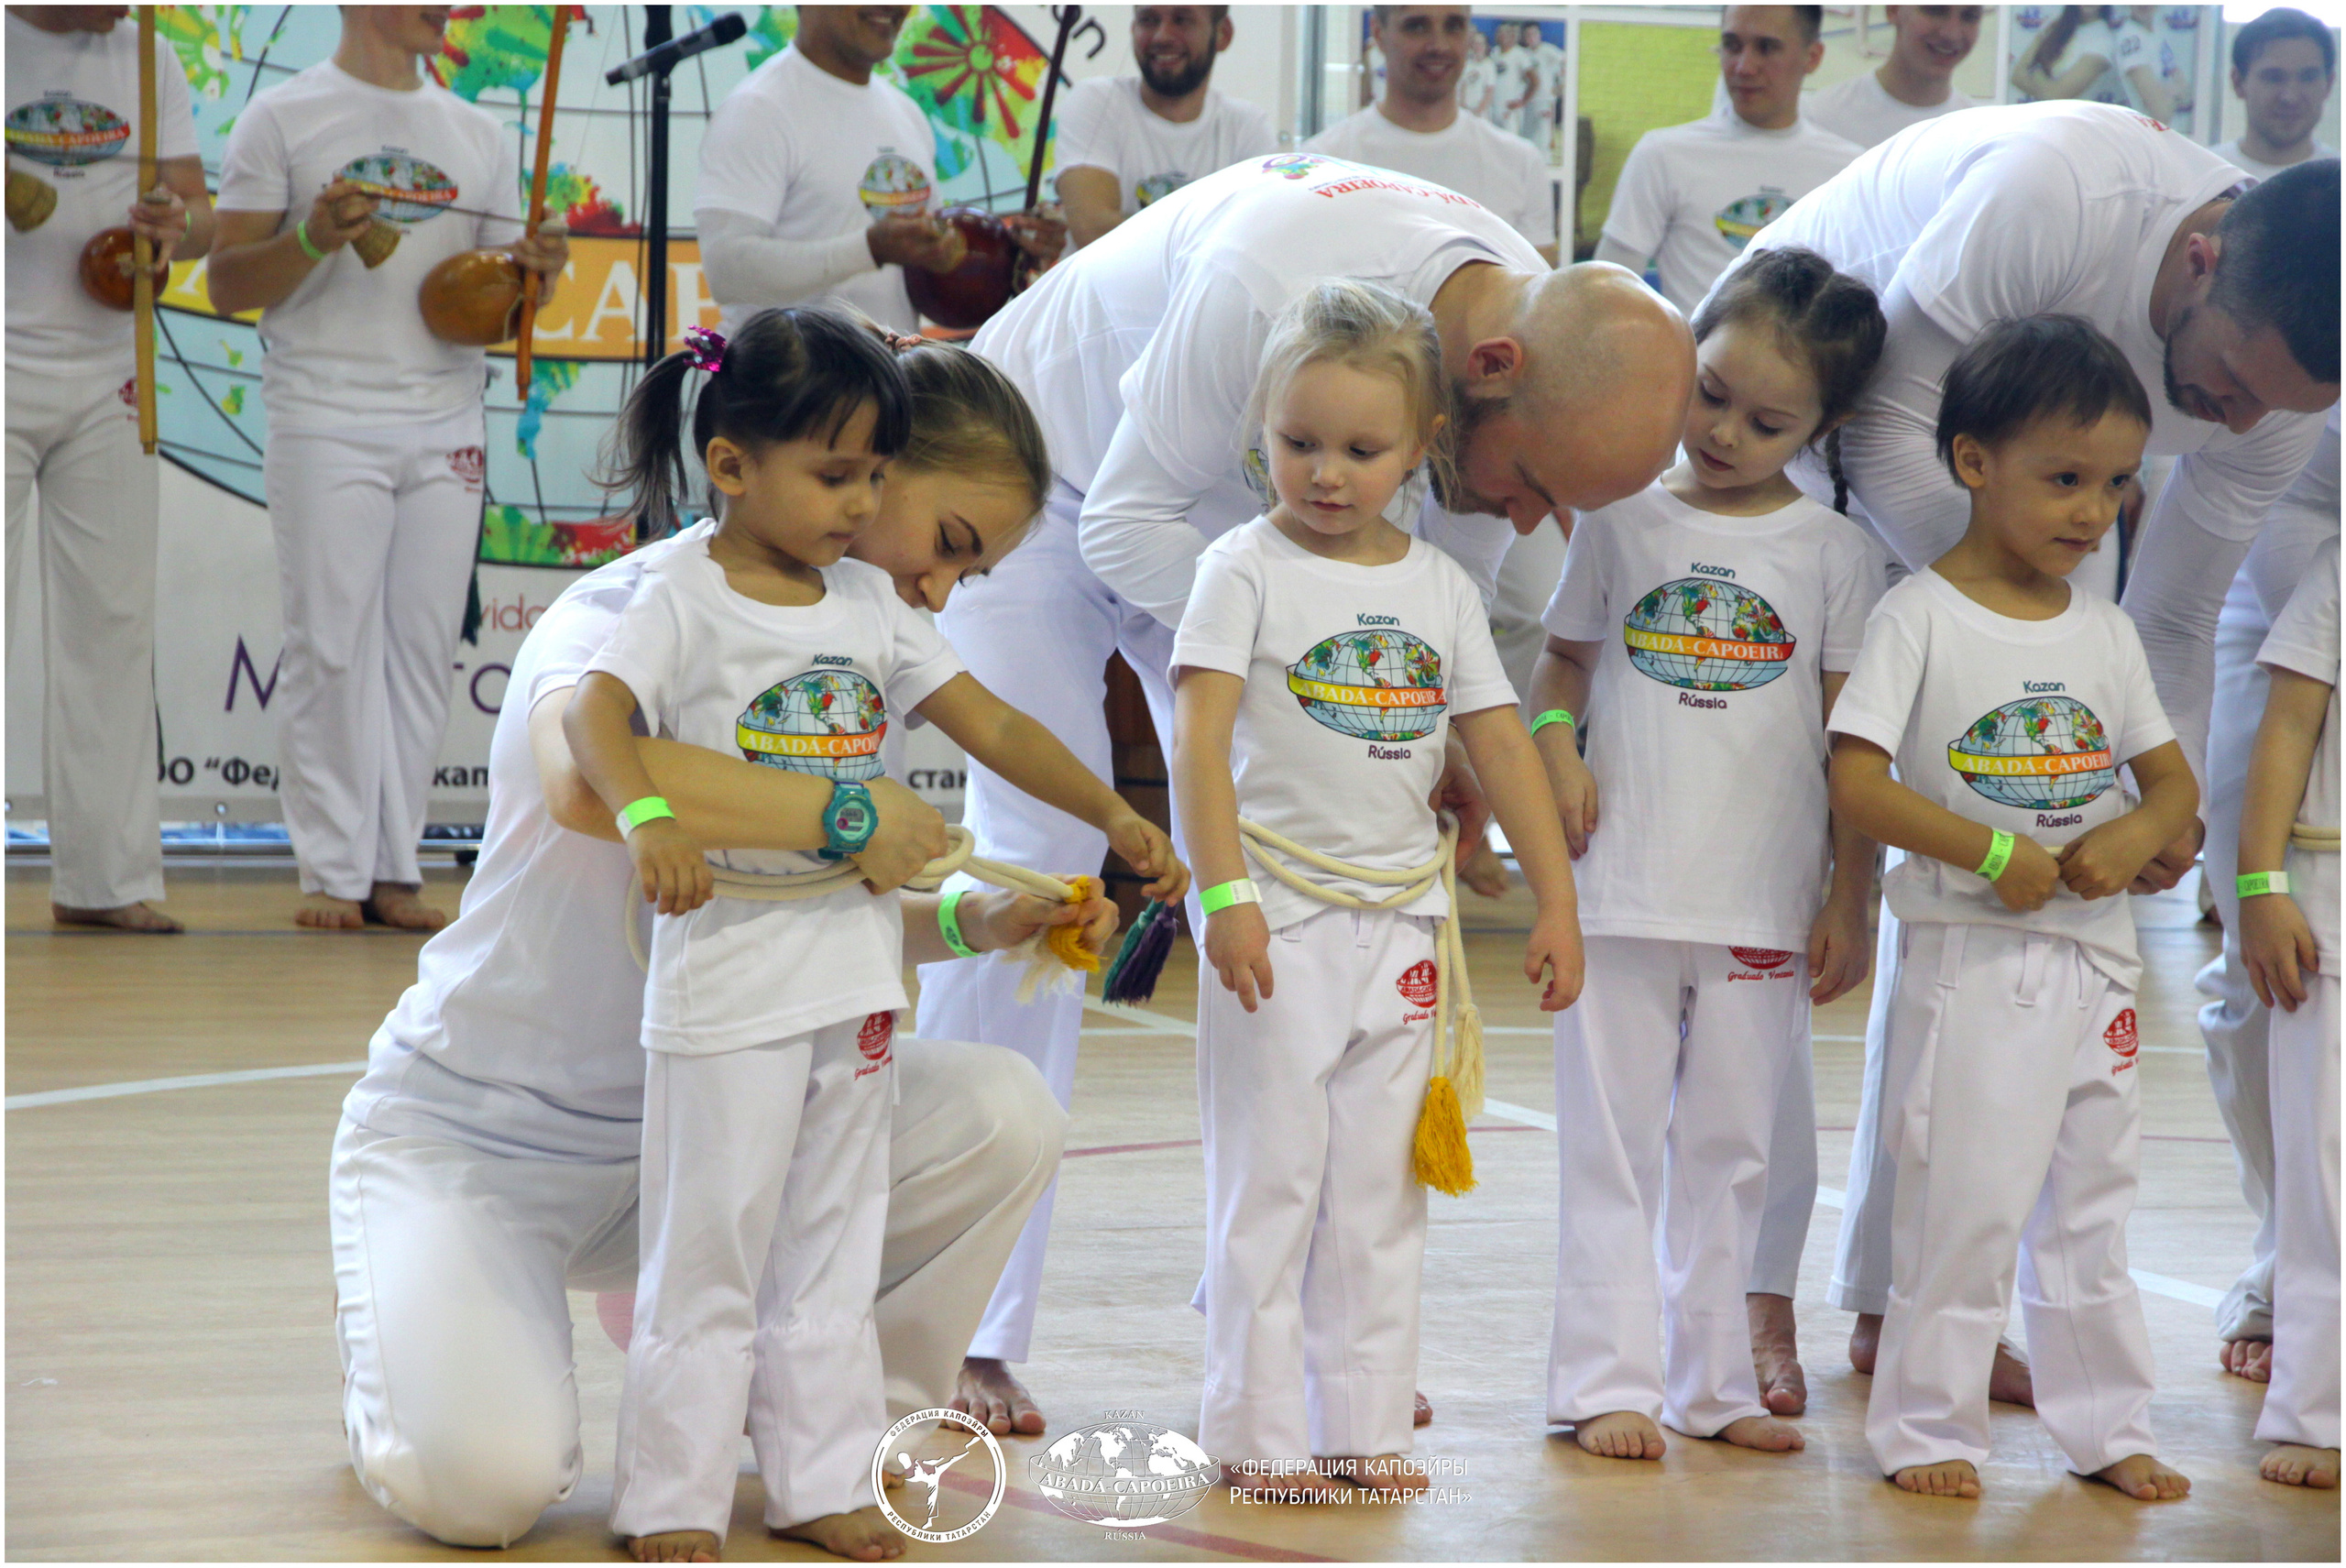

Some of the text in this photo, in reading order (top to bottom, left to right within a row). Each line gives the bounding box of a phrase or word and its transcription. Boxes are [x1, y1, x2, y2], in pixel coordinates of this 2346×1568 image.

[1691, 562, 1736, 579] Kazan
[1356, 613, 1400, 626] Kazan
[1628, 631, 1783, 660] ABADÁ-CAPOEIR
[811, 653, 853, 666] Kazan
[2023, 680, 2066, 694] Kazan
[1678, 692, 1727, 709] Rússia
[1367, 744, 1411, 760] Rússia
[1961, 752, 2111, 774] ABADÁ-CAPOEIR
[2036, 813, 2083, 828] Rússia
